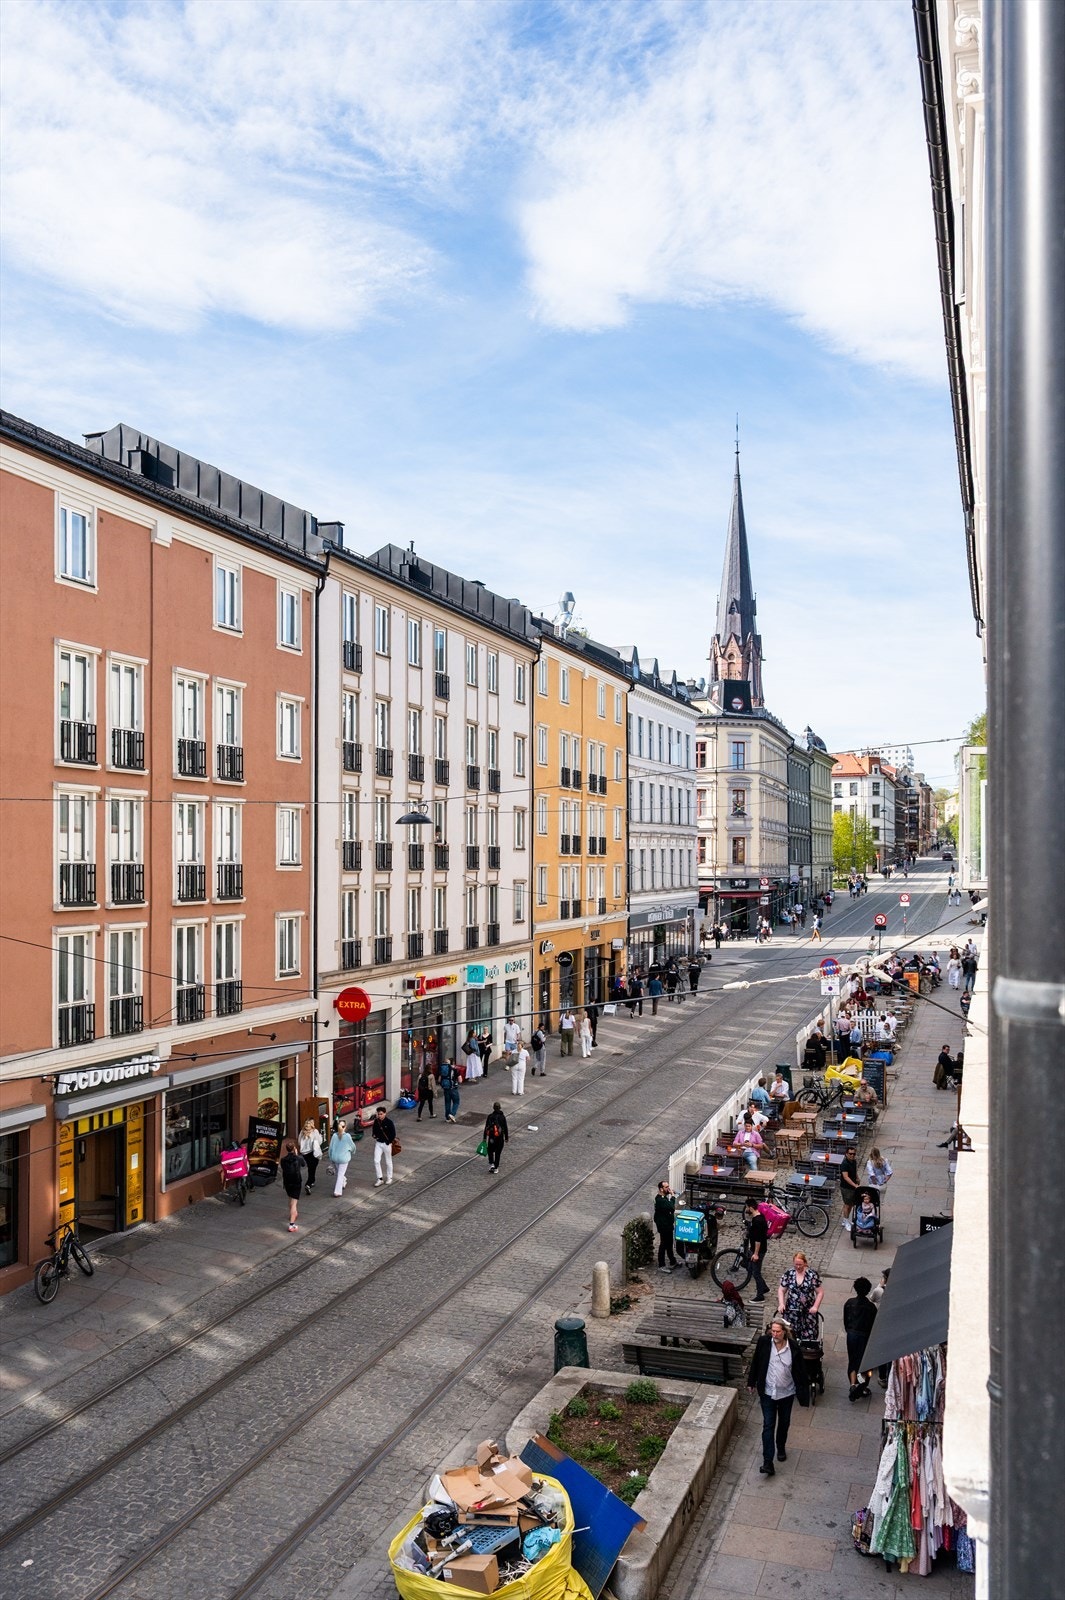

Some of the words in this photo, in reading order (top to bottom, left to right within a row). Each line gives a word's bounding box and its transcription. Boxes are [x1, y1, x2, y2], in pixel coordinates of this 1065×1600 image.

[338, 1001, 366, 1009] EXTRA
[57, 1055, 160, 1095] McDonald's
[678, 1225, 694, 1234] Wolt
